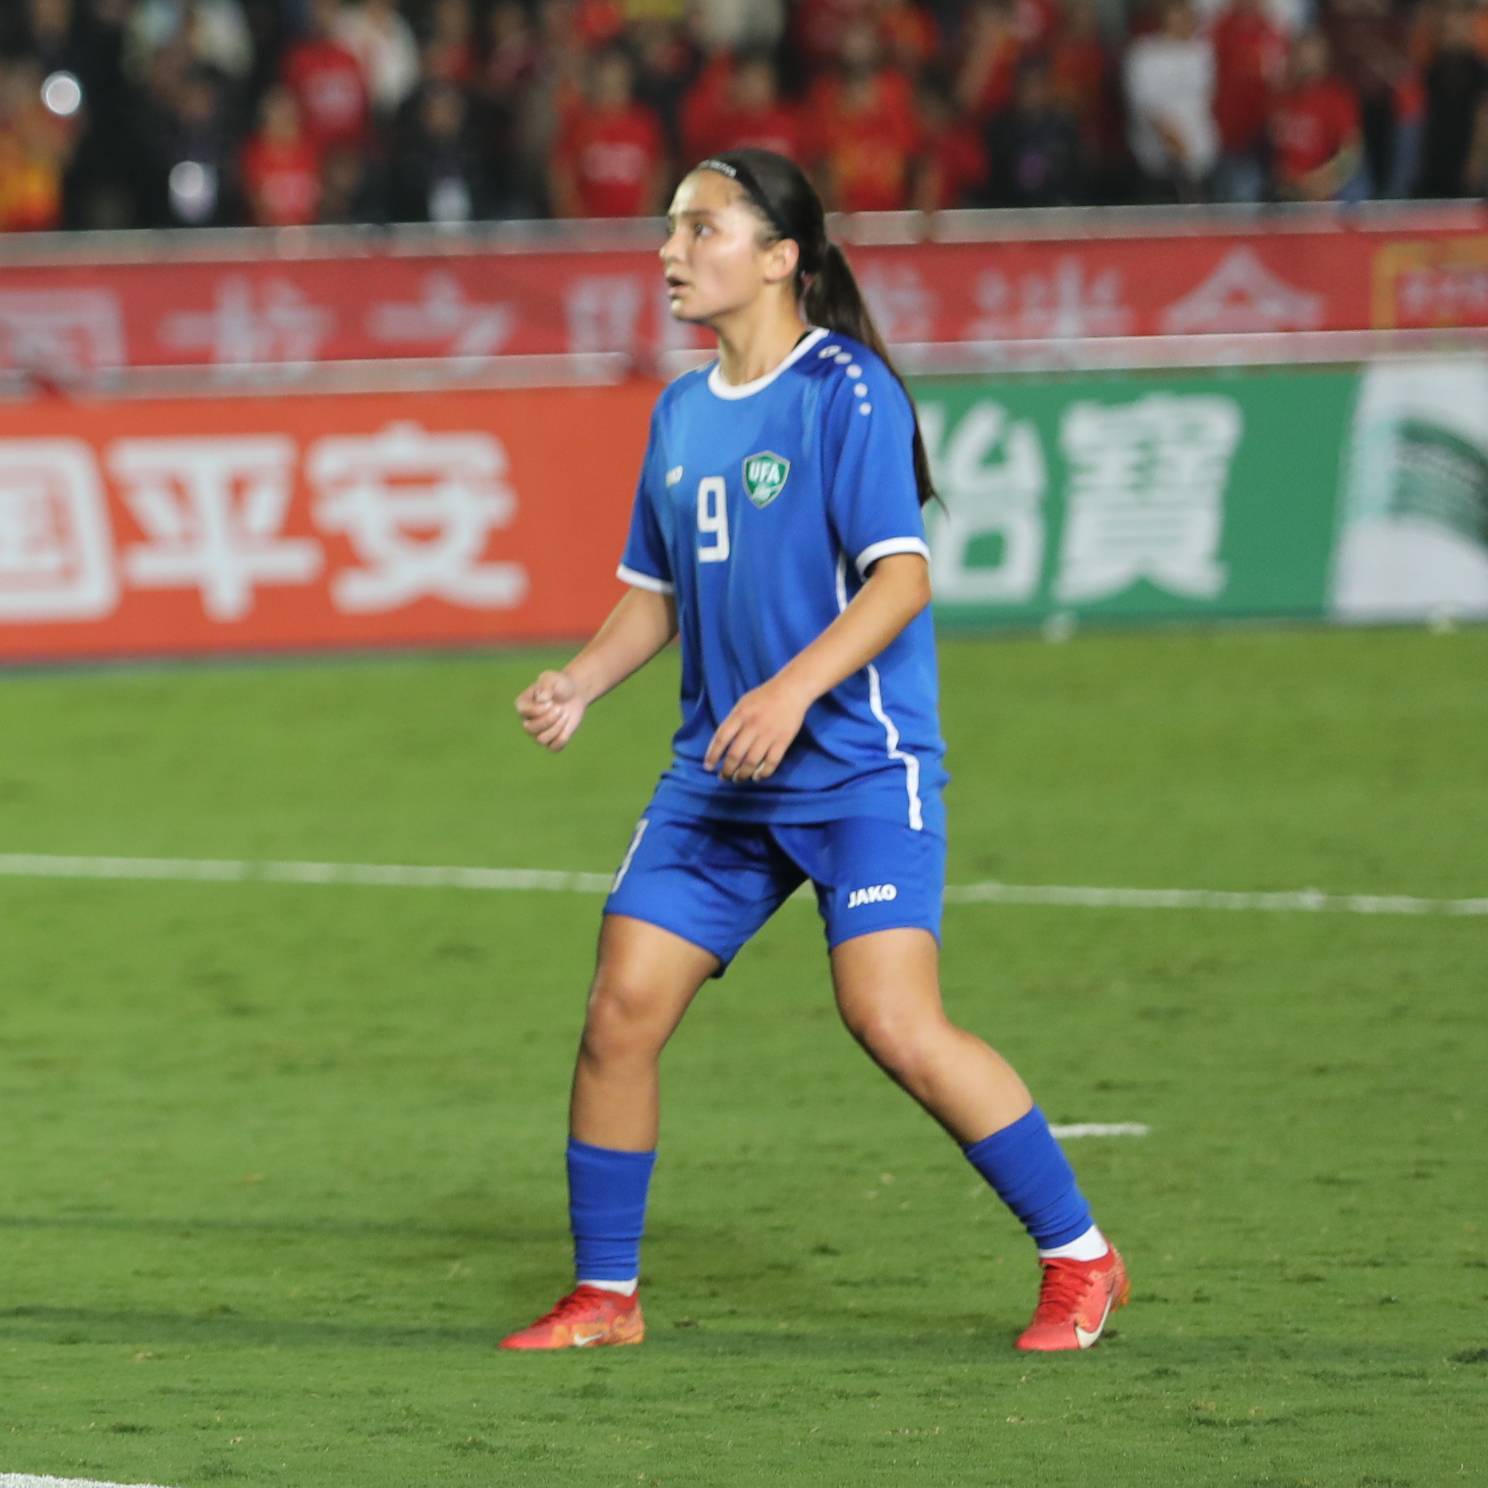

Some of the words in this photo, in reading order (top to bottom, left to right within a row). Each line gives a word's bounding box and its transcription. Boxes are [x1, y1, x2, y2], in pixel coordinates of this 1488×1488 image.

[748, 461, 781, 484] UFA
[697, 475, 730, 563] 9
[847, 883, 898, 909] JAKO
